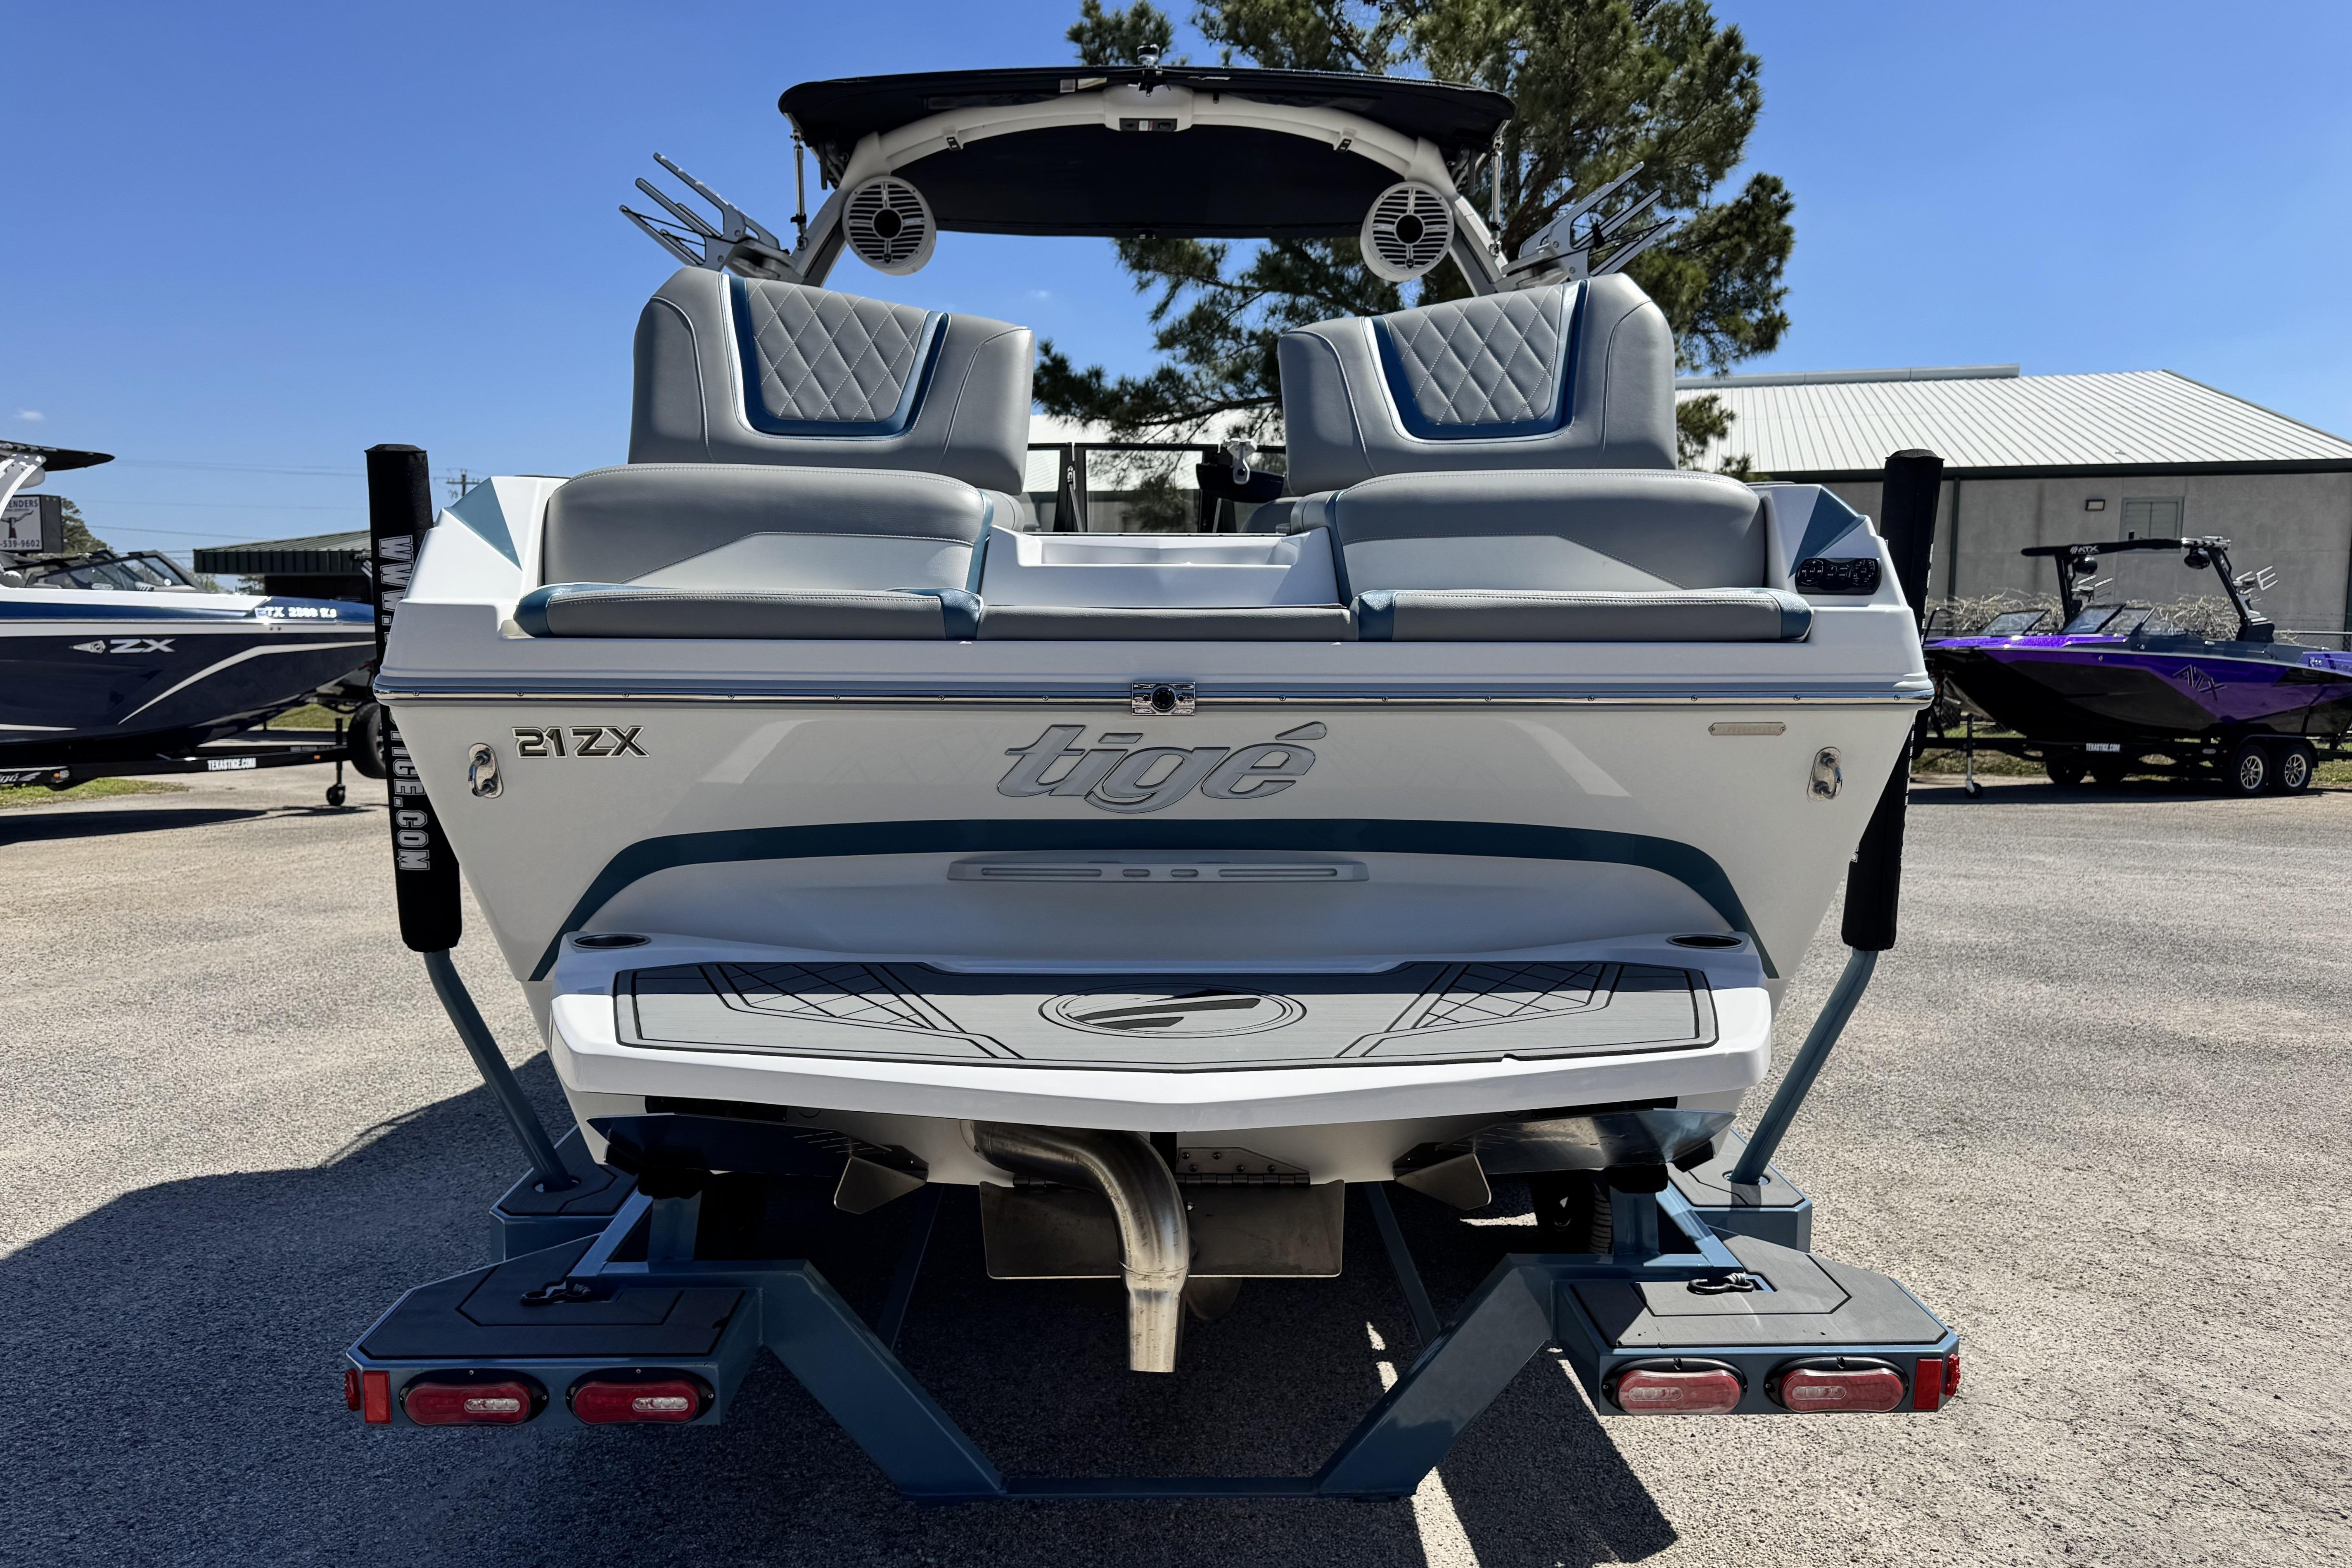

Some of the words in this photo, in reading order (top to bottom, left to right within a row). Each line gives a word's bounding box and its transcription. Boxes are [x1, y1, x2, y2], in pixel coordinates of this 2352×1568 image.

[8, 499, 38, 508] ENDERS
[110, 638, 176, 654] ZX
[996, 721, 1327, 814] tigé
